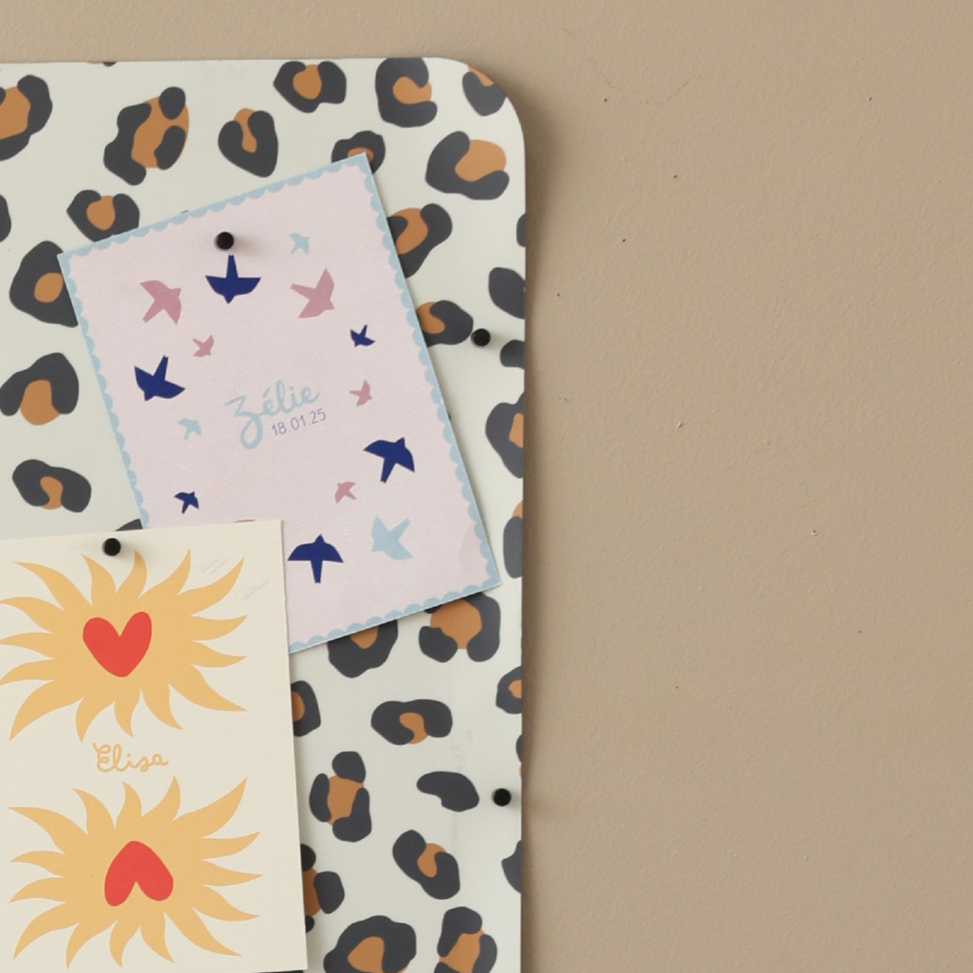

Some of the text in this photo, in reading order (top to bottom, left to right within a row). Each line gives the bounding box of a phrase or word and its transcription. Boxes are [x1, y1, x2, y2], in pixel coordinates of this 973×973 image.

[224, 379, 321, 450] Zélie
[271, 407, 327, 437] 18.01.25
[92, 742, 169, 773] Elisa
